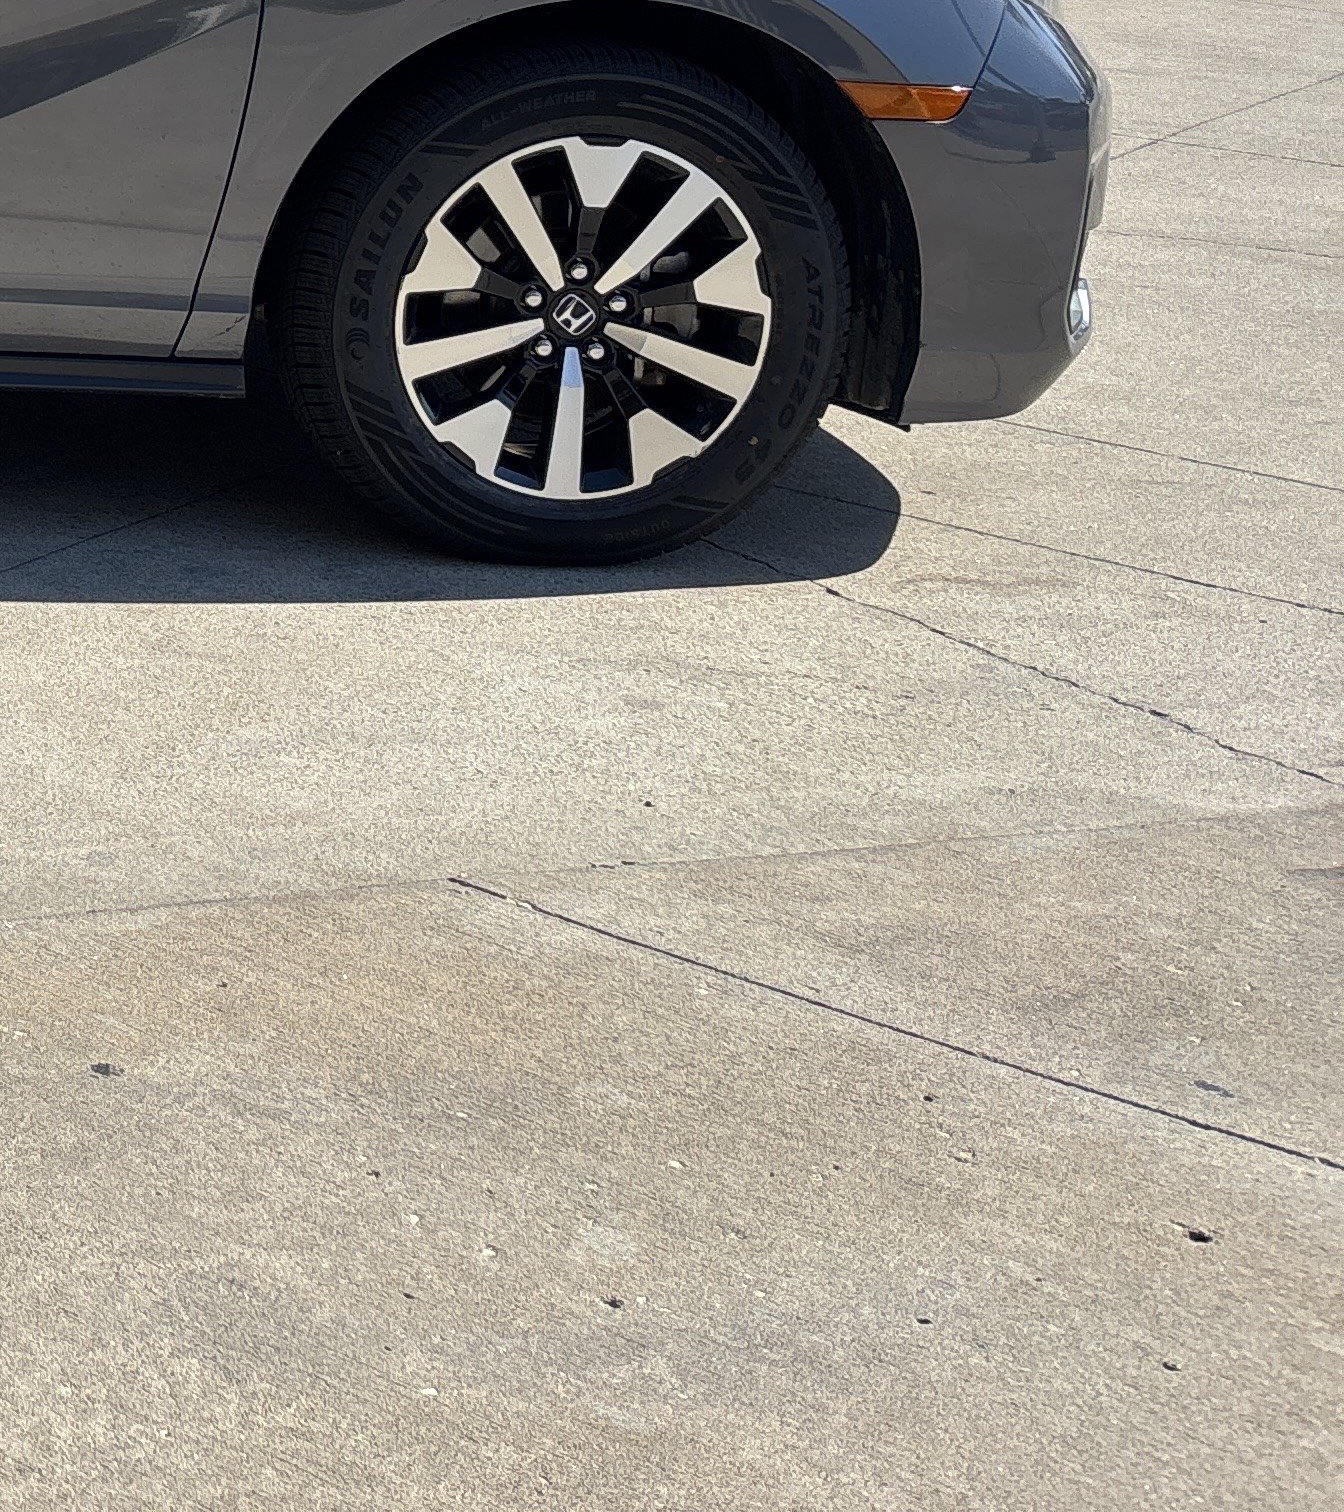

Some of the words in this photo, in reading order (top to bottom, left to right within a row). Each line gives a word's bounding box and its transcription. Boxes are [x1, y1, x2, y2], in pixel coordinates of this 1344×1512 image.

[479, 89, 598, 130] ALL-WEATHER
[349, 172, 424, 316] SAILUN
[777, 256, 824, 430] ATREZZO
